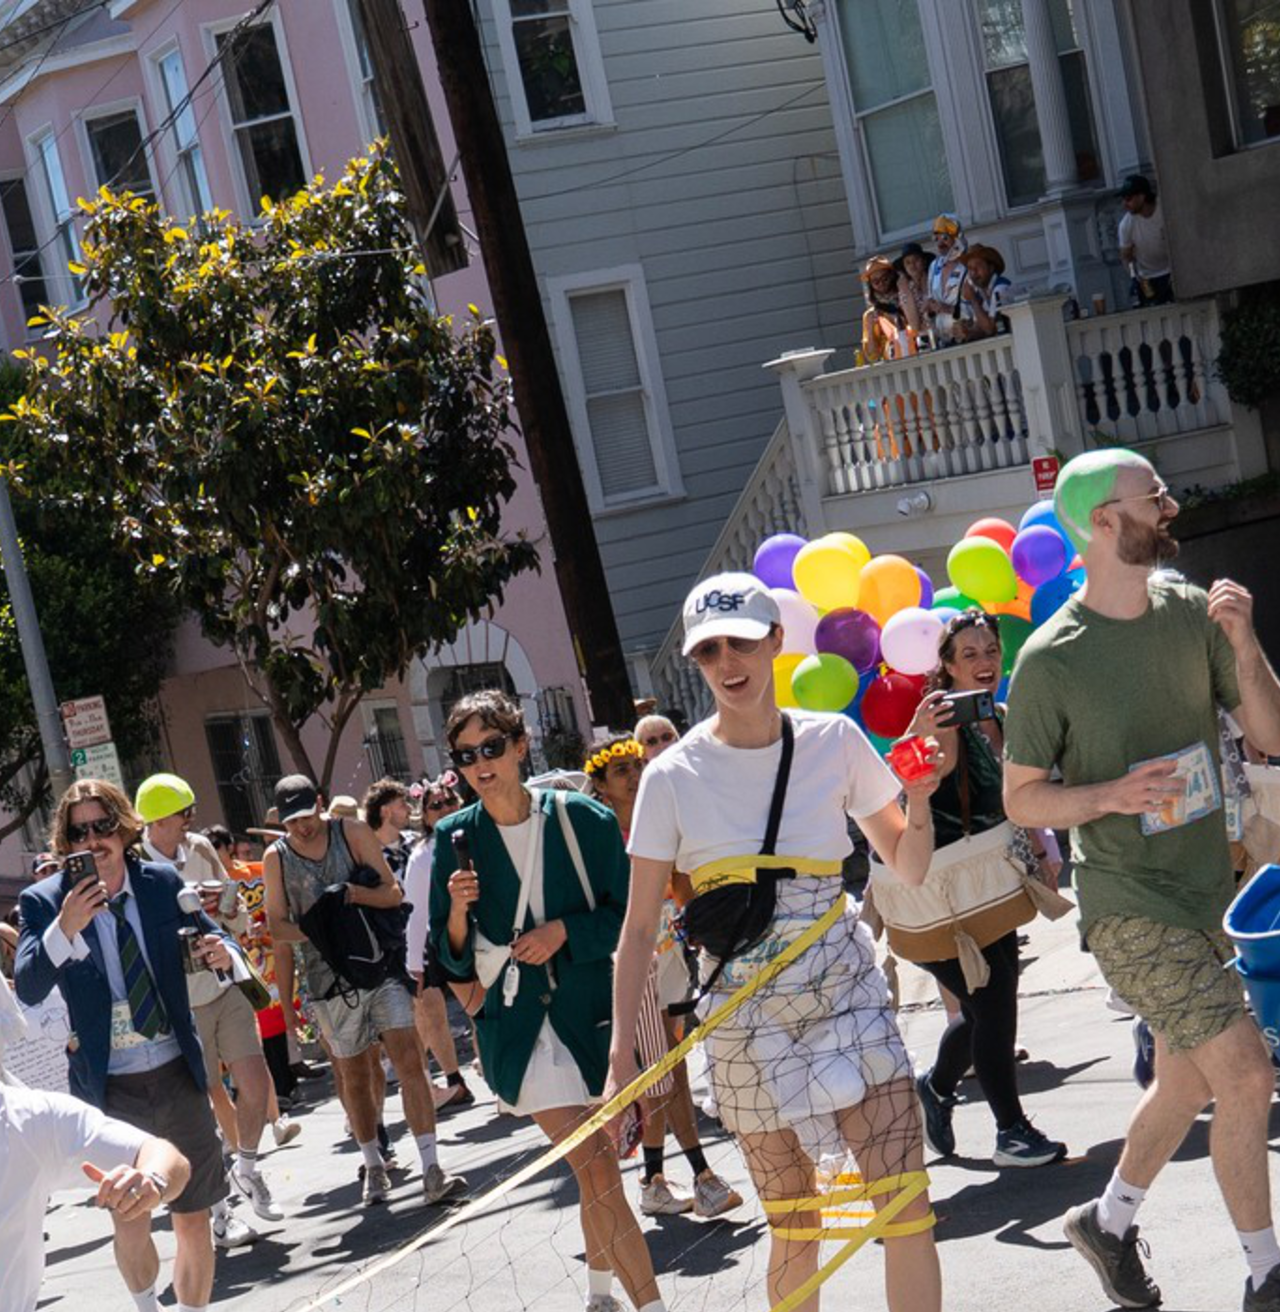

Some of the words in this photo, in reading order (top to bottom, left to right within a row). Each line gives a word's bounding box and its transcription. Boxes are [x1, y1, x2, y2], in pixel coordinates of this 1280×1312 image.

[696, 590, 745, 613] UCSF
[75, 752, 85, 765] 2
[89, 753, 115, 762] PARKING
